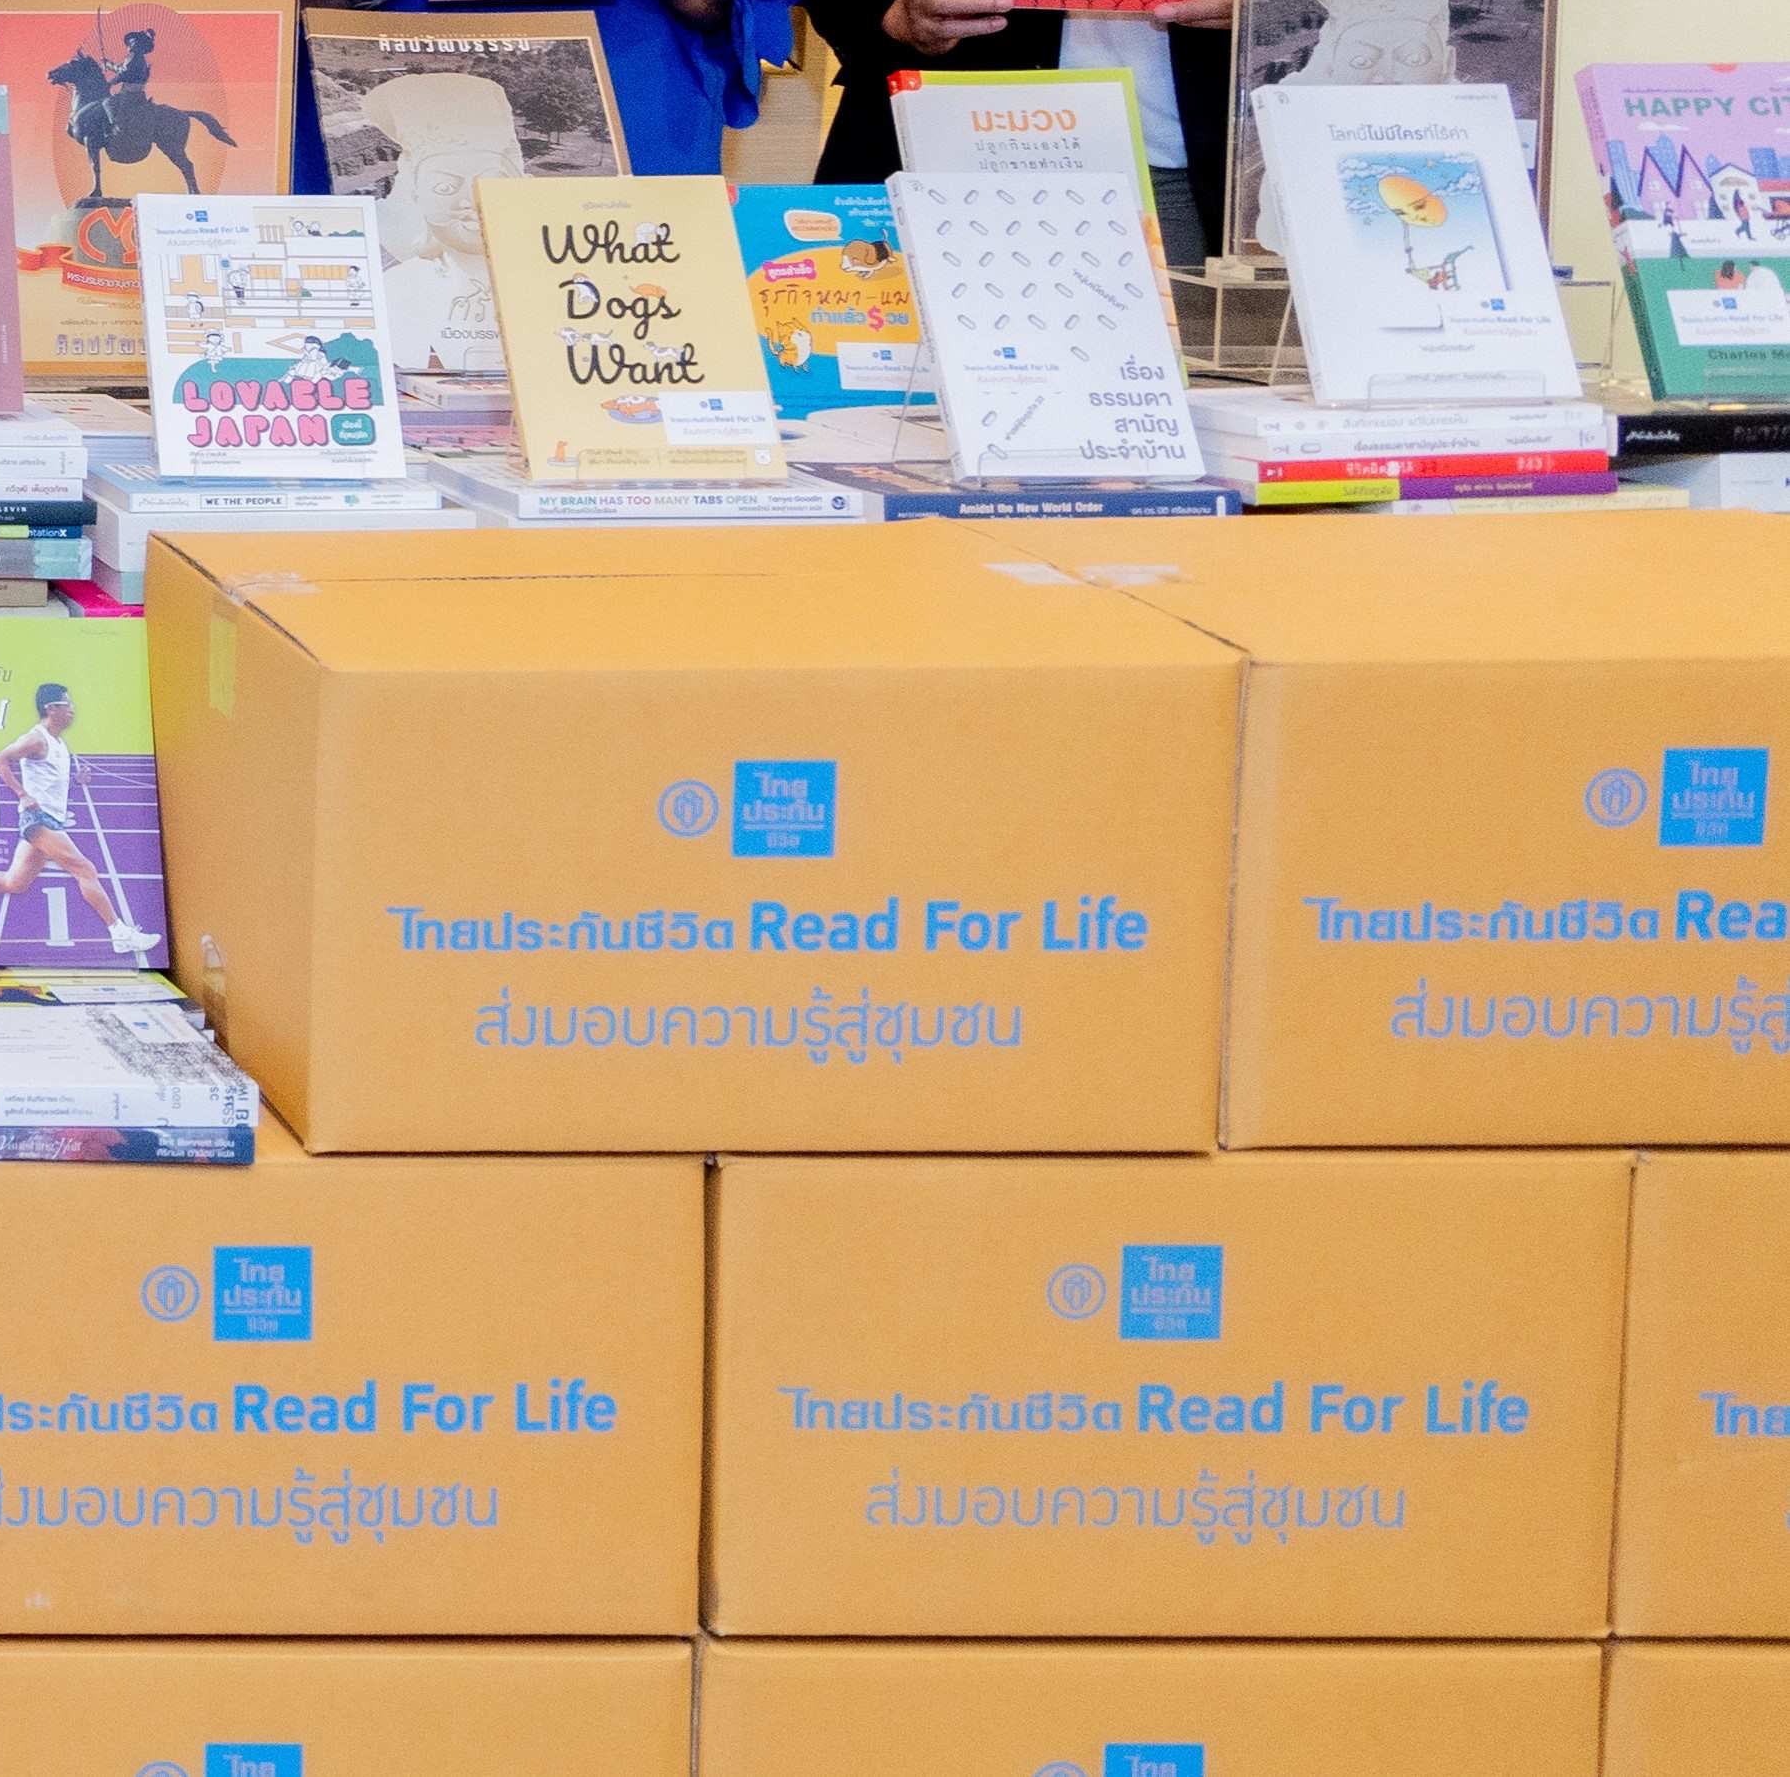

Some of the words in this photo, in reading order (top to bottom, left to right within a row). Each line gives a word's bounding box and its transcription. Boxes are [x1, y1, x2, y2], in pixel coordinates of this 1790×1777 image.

[1624, 96, 1735, 117] HAPPY
[541, 220, 681, 266] What
[558, 279, 682, 340] Dogs
[566, 342, 705, 386] Want
[1119, 355, 1165, 381] เรื่อง
[183, 377, 372, 411] LOVABLE
[1089, 390, 1172, 408] ธรรมดา
[187, 414, 329, 447] JAPAN
[1115, 415, 1179, 435] สามัญ
[1079, 441, 1186, 461] ประจำบ้าน
[205, 497, 221, 507] WE
[223, 497, 243, 507] THE
[245, 497, 282, 506] PEOPLE
[539, 496, 558, 506] MY
[560, 496, 597, 506] BRAIN
[599, 496, 624, 506] HAS
[627, 496, 651, 506] TOO
[654, 496, 690, 506] MANY
[693, 496, 723, 506] TABS
[726, 496, 757, 506] OPEN
[388, 908, 735, 952] ไทยประกันชีวิต
[750, 897, 900, 953] Read
[925, 901, 1023, 952] For
[1044, 896, 1149, 952] Life
[1305, 899, 1660, 943] ไทยประกันชีวิต
[476, 988, 1021, 1065] ส่งมอบความรู้สู่ชุมชน
[782, 1389, 1122, 1432] ไทยประกันชีวิต
[1139, 1382, 1284, 1434] Read
[1311, 1385, 1405, 1434] For
[1427, 1381, 1530, 1435] Life
[866, 1470, 1406, 1549] ส่งมอบความรู้สู่ชุมชน
